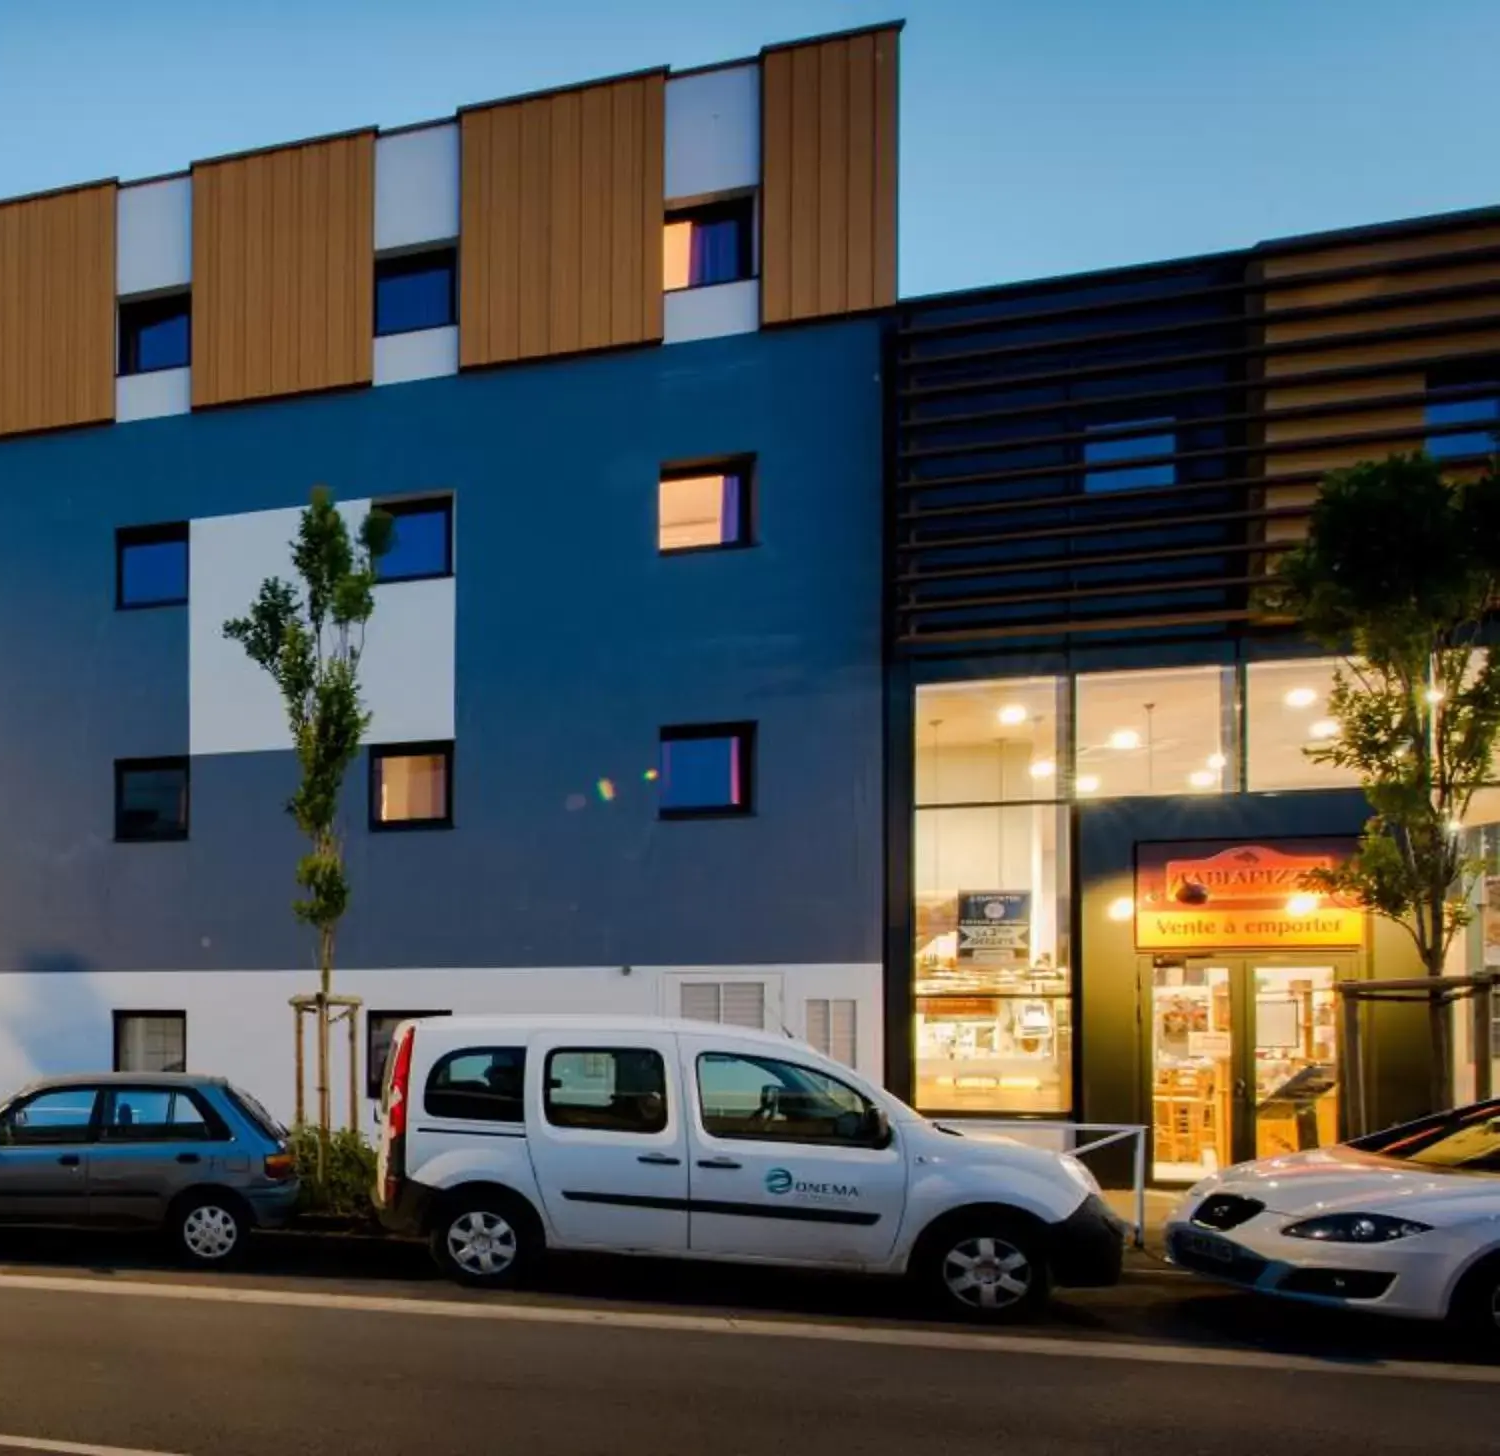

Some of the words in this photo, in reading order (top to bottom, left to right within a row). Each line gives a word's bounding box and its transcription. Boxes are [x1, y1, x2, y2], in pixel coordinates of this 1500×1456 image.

[1155, 918, 1216, 936] Vente
[1224, 918, 1237, 934] à
[1244, 917, 1342, 937] emporter
[796, 1181, 859, 1197] ONEMA
